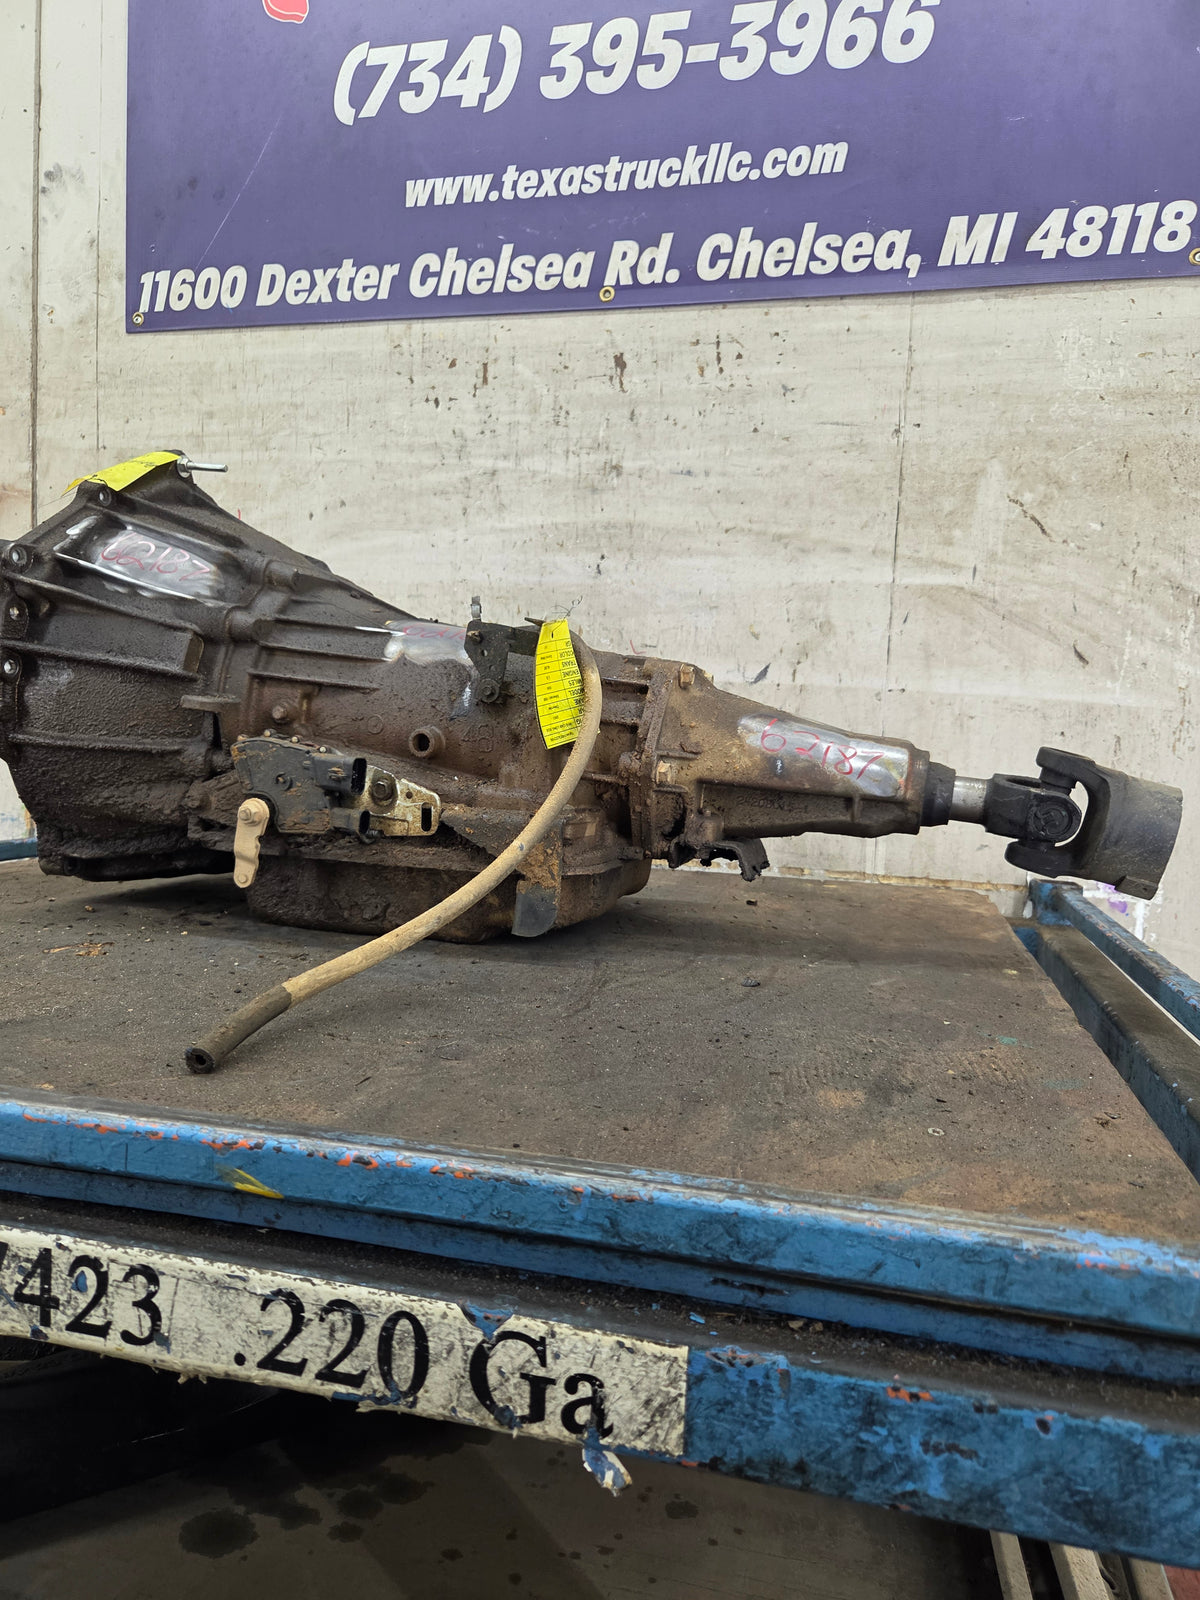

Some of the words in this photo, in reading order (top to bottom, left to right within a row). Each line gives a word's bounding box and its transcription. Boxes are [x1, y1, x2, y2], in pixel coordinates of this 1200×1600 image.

[333, 24, 523, 127] (734)
[538, 0, 937, 100] 395-3966
[405, 142, 849, 208] www.texastruckllc.com
[138, 264, 248, 313] 11600
[255, 257, 400, 307] Dexter
[408, 243, 595, 299] Chelsea
[603, 232, 681, 287] Rd.
[696, 222, 922, 282] Chelsea,
[937, 211, 1019, 267] MI
[1024, 199, 1198, 260] 48118
[761, 718, 884, 780] 62187
[0, 1240, 163, 1347] 423
[468, 1331, 614, 1438] Ga
